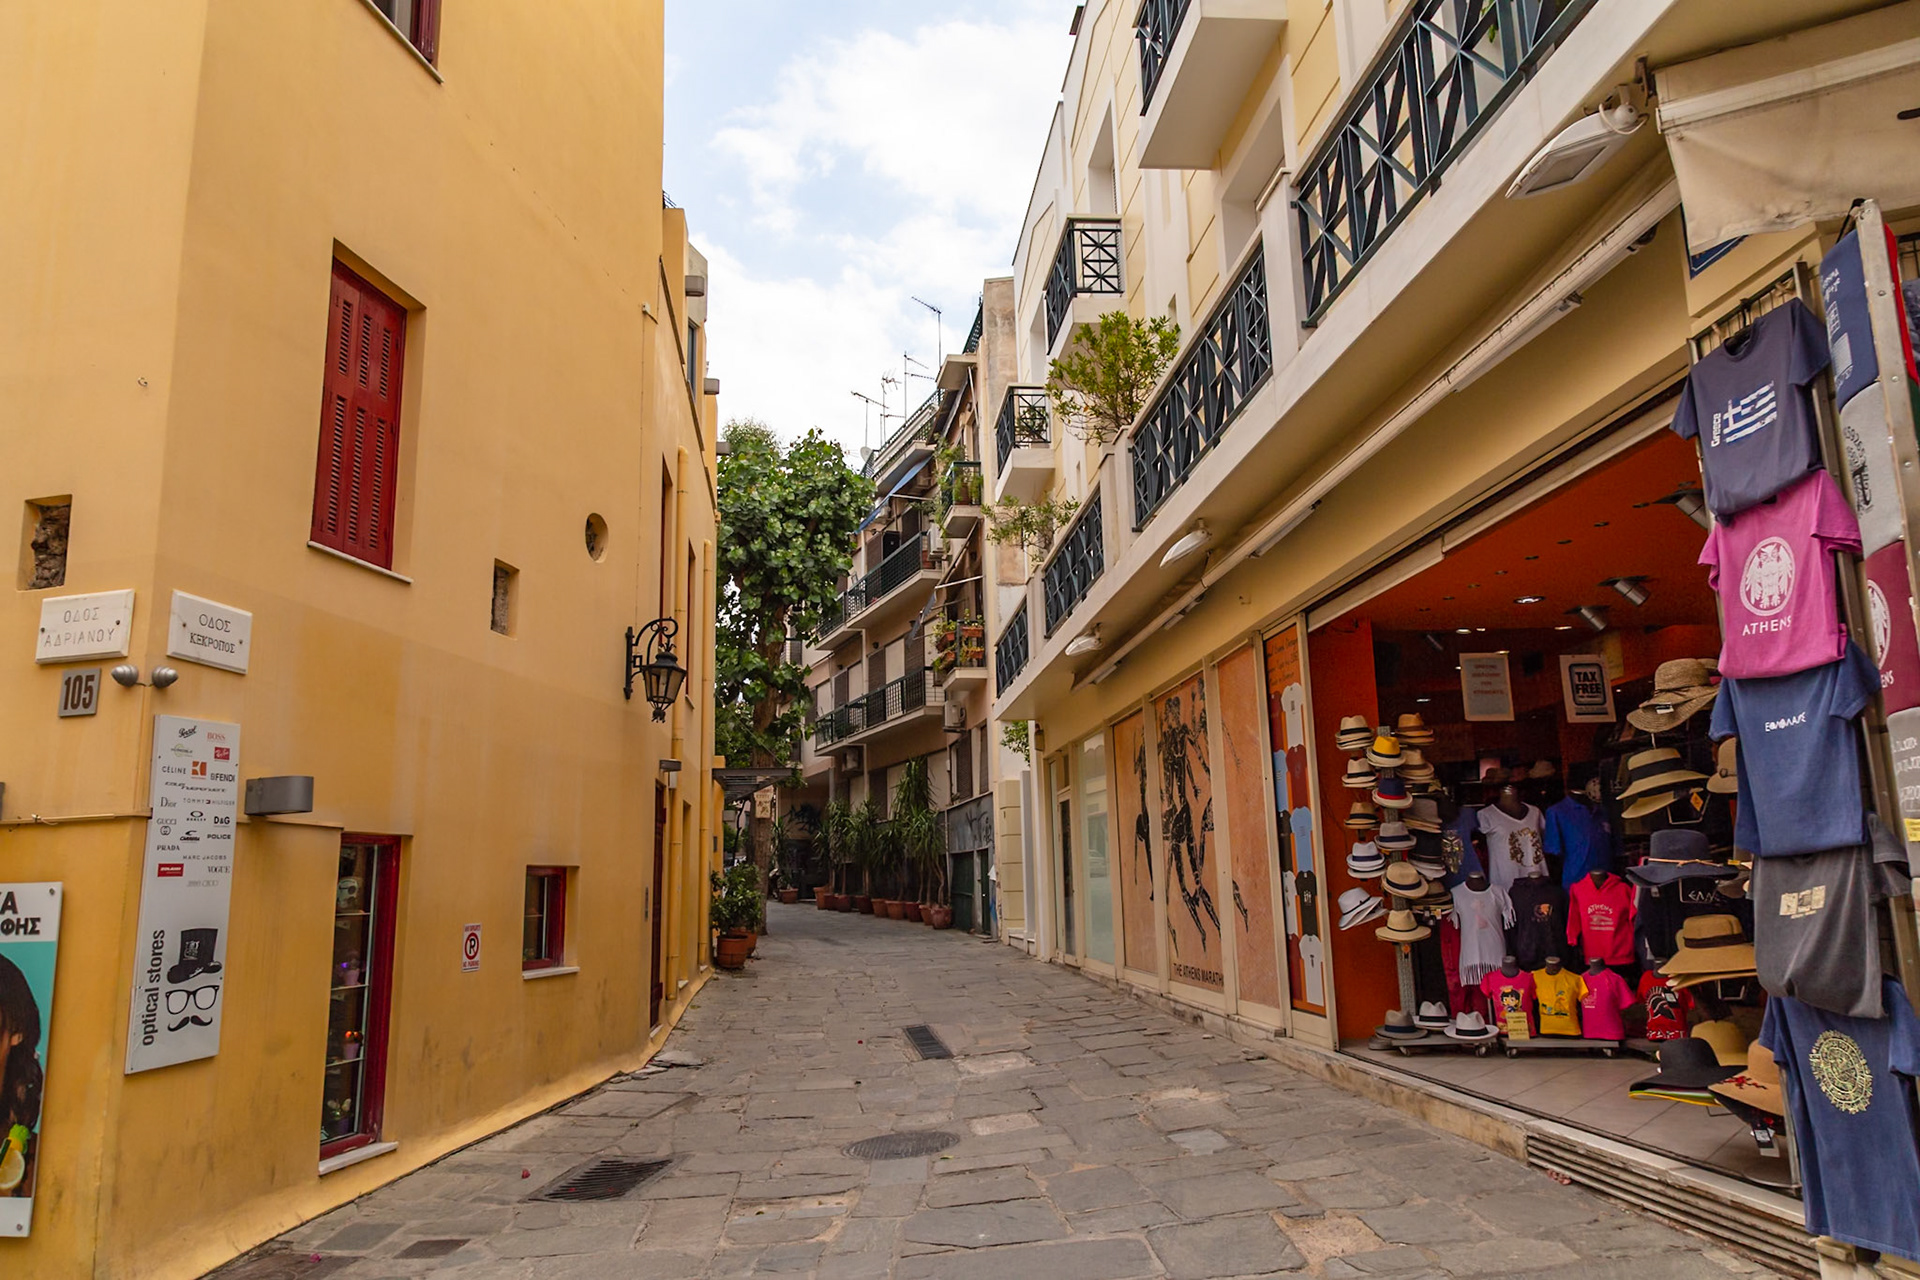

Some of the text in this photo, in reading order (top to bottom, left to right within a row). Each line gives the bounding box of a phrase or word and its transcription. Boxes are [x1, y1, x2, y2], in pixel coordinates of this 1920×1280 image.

[1710, 412, 1722, 448] Greece
[63, 607, 100, 624] ΟΔΟΣ
[198, 613, 231, 633] ΟΔΟΣ
[1742, 615, 1792, 636] ATHENS
[44, 628, 115, 647] ΑΔΡΙΑΝΟΥ
[189, 632, 236, 654] ΚΕΚΡΟΠΟΣ
[1575, 671, 1597, 683] TAX
[1880, 670, 1895, 688] ENS
[63, 674, 95, 711] 105
[1575, 683, 1602, 695] FREE
[207, 732, 226, 740] BOSS
[161, 765, 187, 775] CÉLINE
[215, 773, 235, 782] FENDI
[156, 817, 177, 825] GUCCI
[213, 816, 230, 825] D&G
[207, 865, 231, 873] VOGUE
[0, 891, 18, 915] Α
[1173, 962, 1183, 977] THE
[1183, 965, 1201, 982] ATHENS
[142, 929, 165, 1046] optical stores
